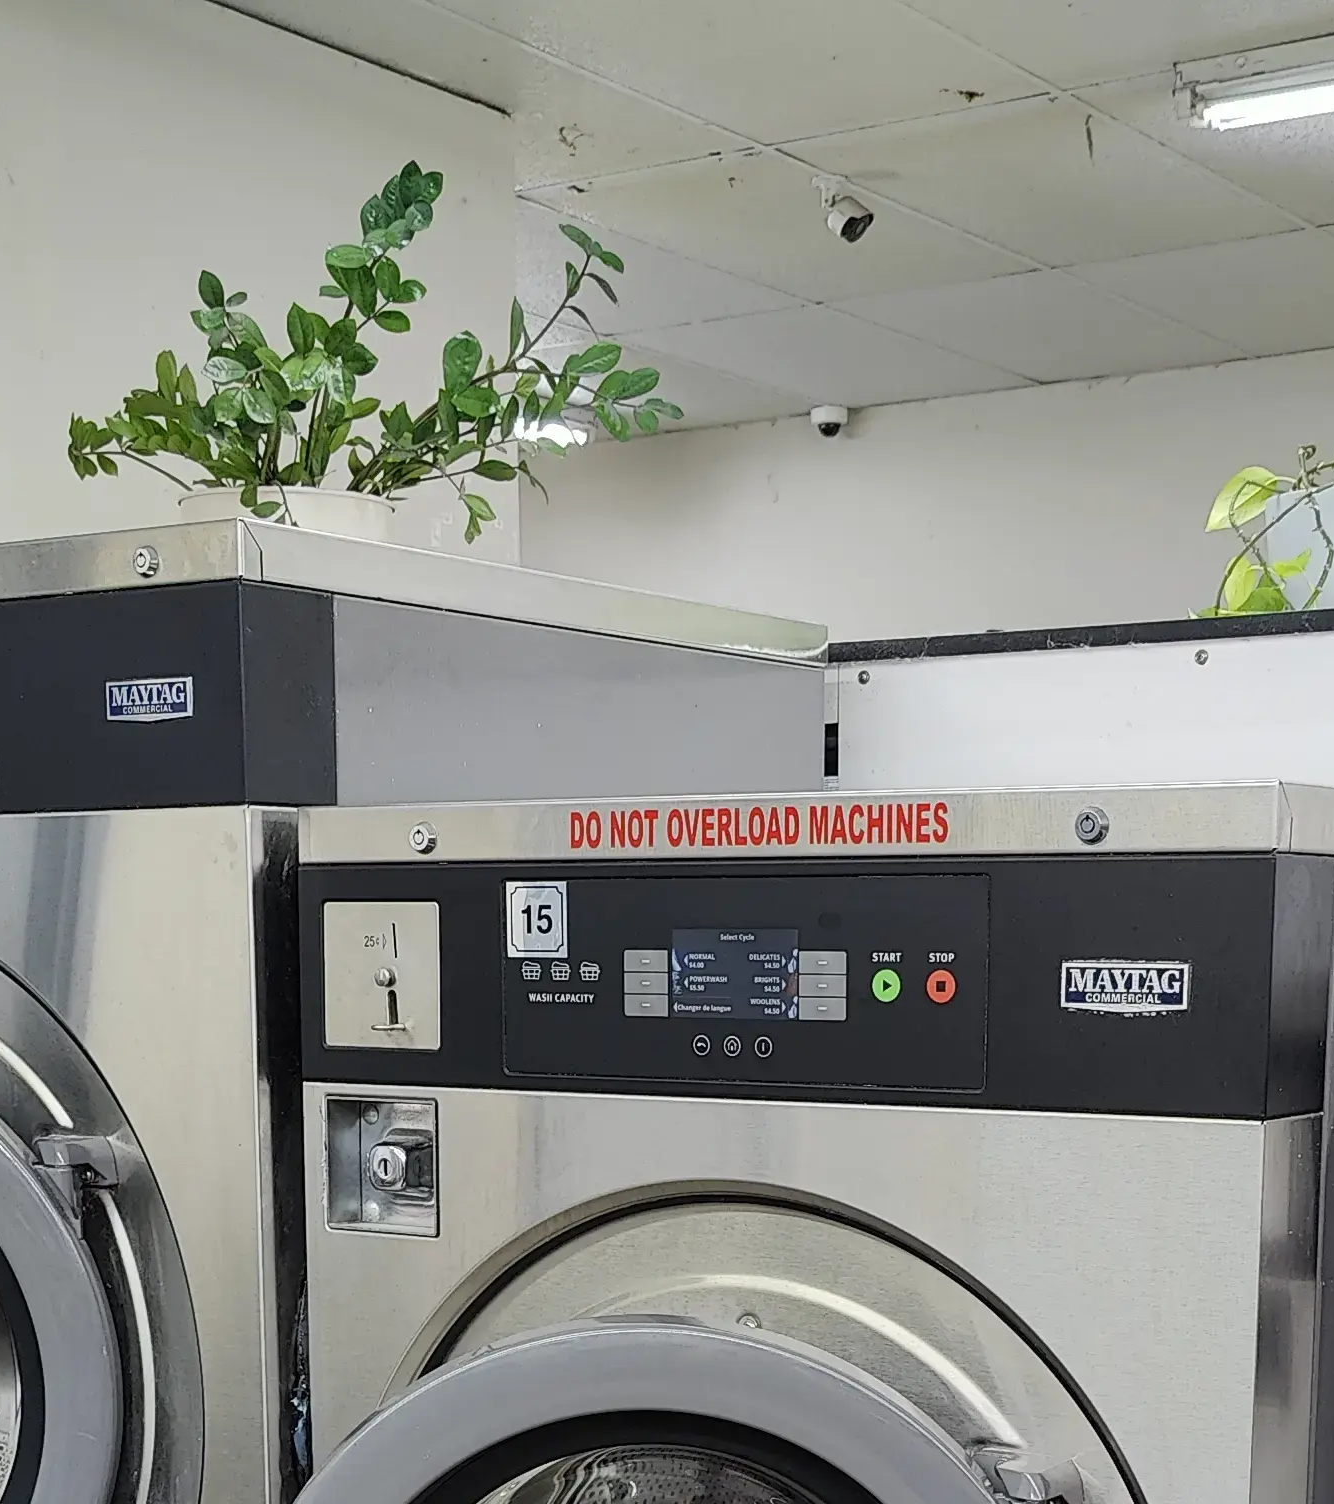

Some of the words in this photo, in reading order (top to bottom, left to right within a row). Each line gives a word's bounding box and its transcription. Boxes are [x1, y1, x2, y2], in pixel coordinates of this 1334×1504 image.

[110, 683, 185, 707] MAYTAG
[122, 704, 173, 714] COMMERCIAL
[570, 811, 601, 849] DO
[610, 809, 659, 849] NOT
[667, 806, 799, 847] OVERLOAD
[809, 802, 949, 845] MACHINES
[521, 905, 553, 935] 15
[738, 934, 755, 942] Cycle
[689, 953, 716, 961] NORMAL
[749, 953, 781, 961] DELICATES
[872, 952, 902, 963] START
[928, 952, 955, 963] STOP
[689, 961, 705, 969] $4.00
[754, 976, 780, 984] BRIGHTS
[1068, 968, 1181, 994] MAYTAG
[764, 985, 780, 993] $4.50
[528, 992, 552, 1003] WASH
[555, 993, 595, 1004] CAPACITY
[750, 998, 781, 1006] WOOLENS
[1085, 992, 1162, 1004] COMMERCIAL
[702, 1004, 710, 1012] de
[710, 1004, 732, 1013] langue
[764, 1007, 780, 1015] $4.50
